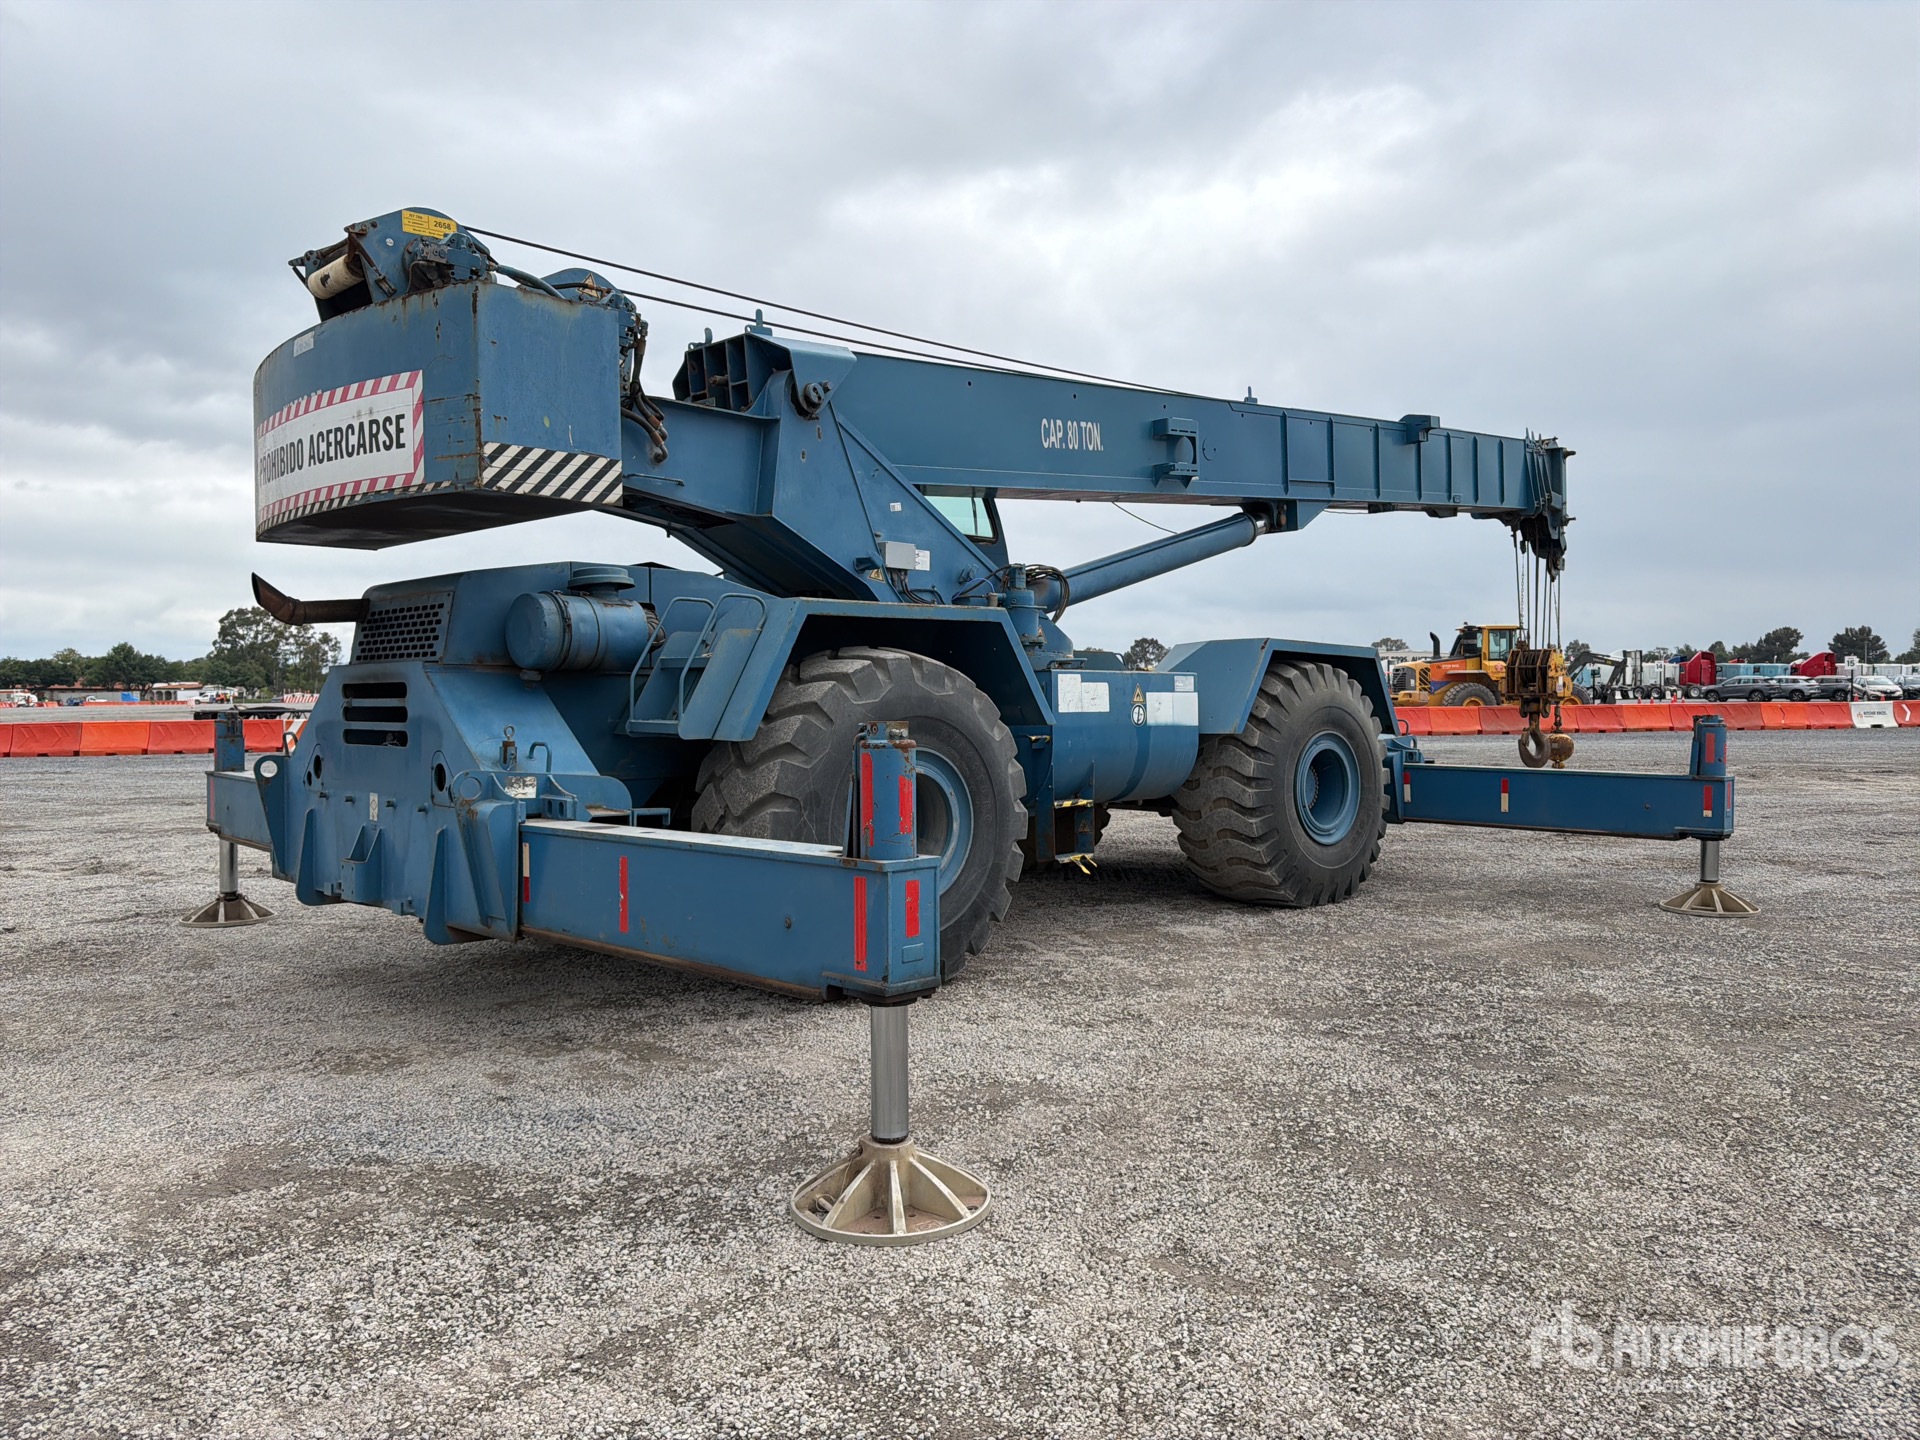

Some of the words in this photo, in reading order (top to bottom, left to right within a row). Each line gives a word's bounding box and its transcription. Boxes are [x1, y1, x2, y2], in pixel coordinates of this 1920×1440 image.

[433, 220, 452, 231] 2658
[258, 437, 304, 488] PROHIBIDO
[308, 413, 406, 467] ACERCARSE
[1041, 418, 1066, 449] CAP.
[1067, 420, 1079, 450] 80
[1080, 421, 1104, 452] TON.
